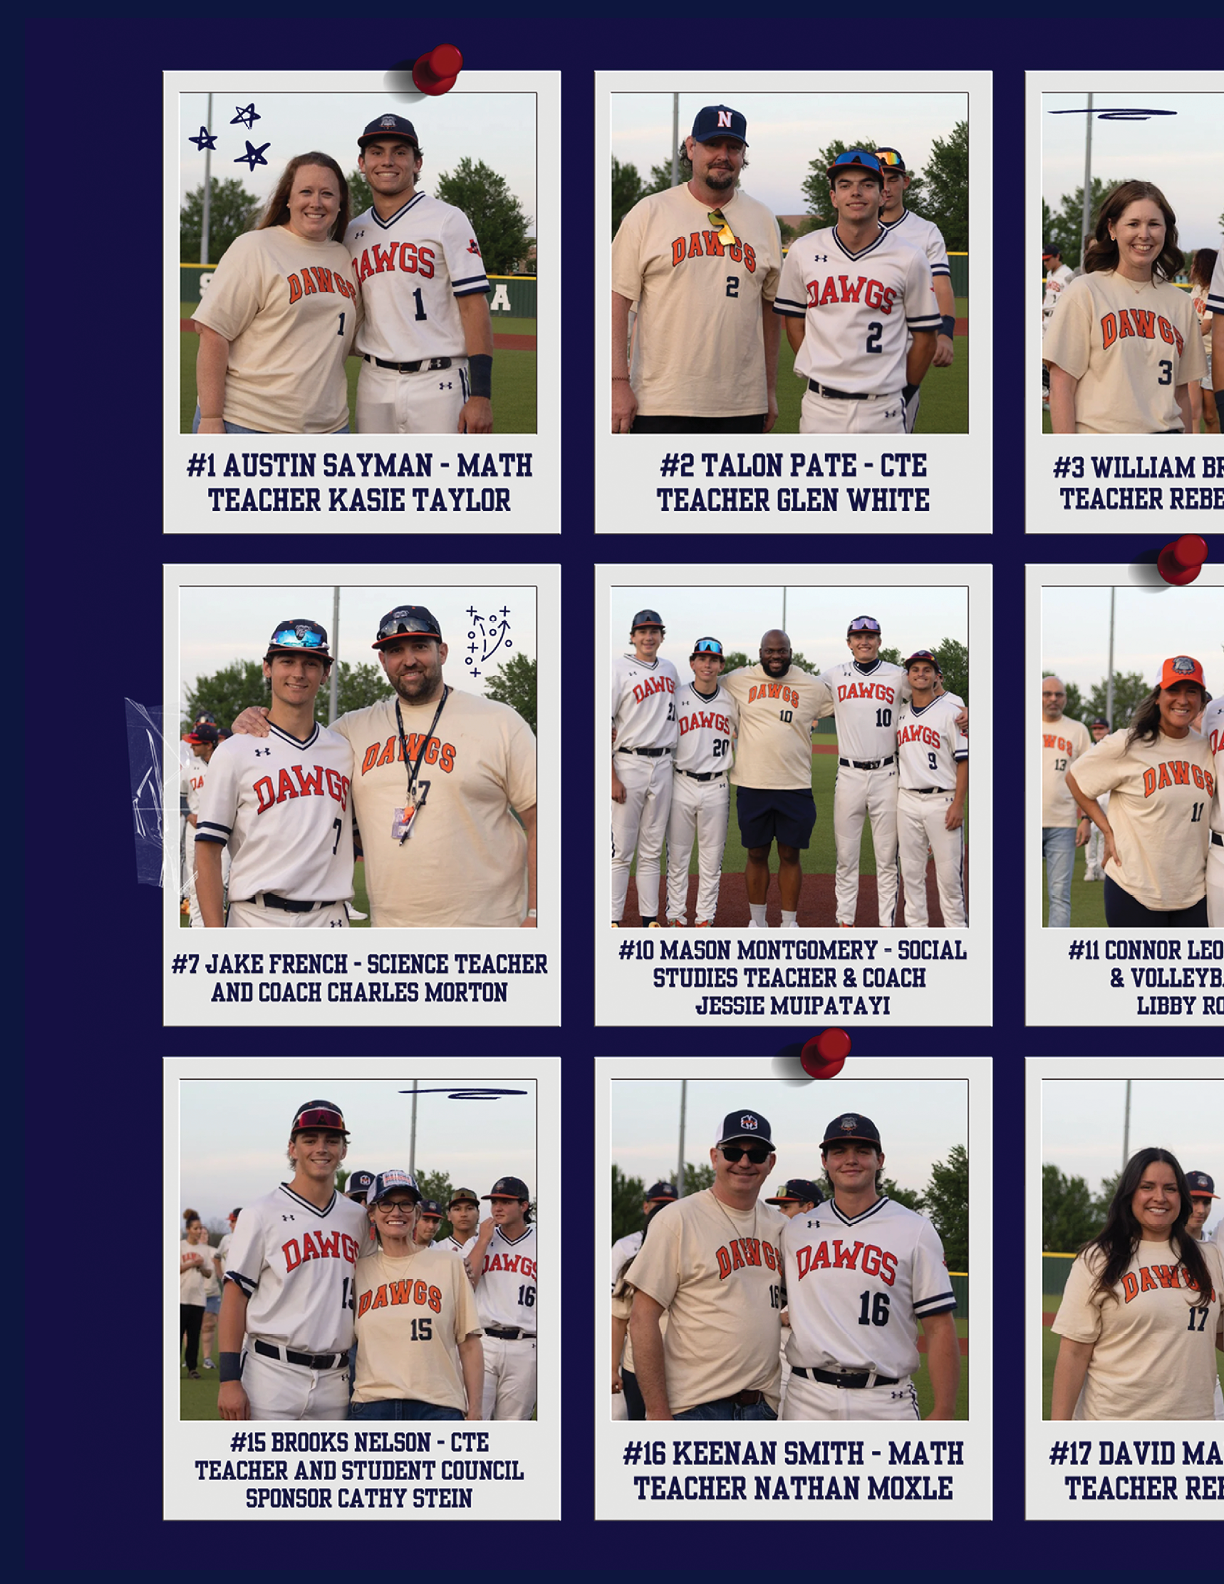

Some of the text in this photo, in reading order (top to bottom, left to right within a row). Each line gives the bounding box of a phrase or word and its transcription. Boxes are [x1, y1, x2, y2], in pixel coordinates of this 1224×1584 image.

[718, 111, 732, 127] N
[413, 287, 427, 320] 1
[490, 284, 511, 311] A
[806, 276, 897, 315] DAWGS
[1158, 360, 1172, 385] 3
[838, 682, 895, 704] DAWGS
[712, 739, 729, 757] 20
[1055, 758, 1066, 771] 13
[332, 818, 342, 855] 7
[796, 1240, 898, 1286] DAWGS
[358, 1279, 442, 1318] DAWGS
